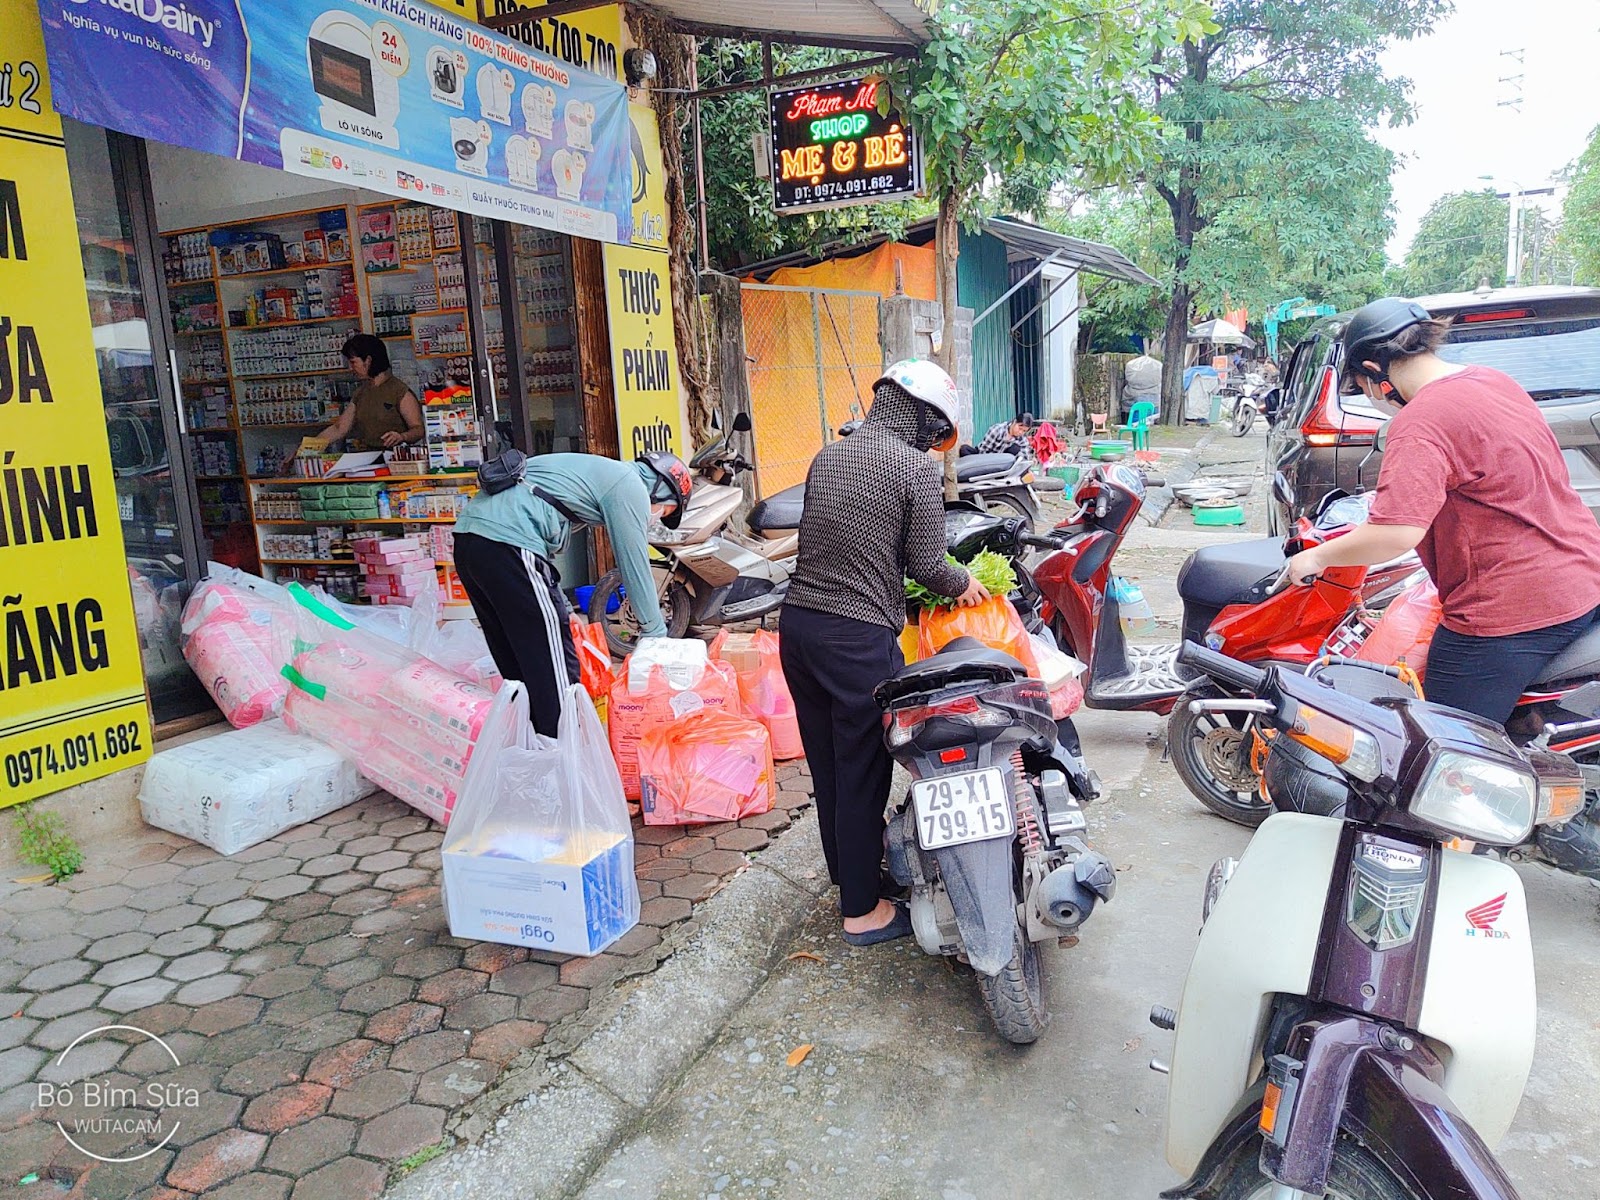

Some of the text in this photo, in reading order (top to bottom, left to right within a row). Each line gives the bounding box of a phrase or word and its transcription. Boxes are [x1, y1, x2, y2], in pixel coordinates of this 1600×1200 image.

[62, 9, 100, 32] Nghĩa
[103, 25, 119, 40] vụ
[121, 30, 143, 45] vun
[163, 45, 182, 60] sức
[184, 51, 211, 70] sống
[381, 0, 426, 26] KHÁCH
[430, 14, 463, 40] HÀNG
[467, 31, 493, 54] 100%
[496, 43, 528, 68] TRÚNG
[381, 31, 397, 48] 24
[381, 50, 402, 66] ĐIỂM
[19, 61, 41, 114] 2
[786, 93, 842, 119] Phạm
[338, 120, 383, 140] LÒ VI SÓNG
[810, 114, 869, 141] SHOP
[781, 144, 825, 184] MẸ
[832, 141, 858, 172] &
[864, 124, 907, 168] BÉ
[814, 175, 894, 198] 0974.091.682
[520, 204, 541, 216] TRUNG
[655, 213, 663, 241] 2
[618, 268, 661, 325] THỰC
[622, 331, 670, 392] PHẨM
[0, 593, 110, 691] ÃNG
[618, 704, 644, 712] moony
[703, 697, 725, 705] oony
[5, 721, 142, 788] 0974.091.682
[926, 773, 990, 812] 29-X1
[923, 803, 1006, 844] 799.15
[1371, 848, 1415, 864] HONDA
[520, 924, 555, 943] Oggi
